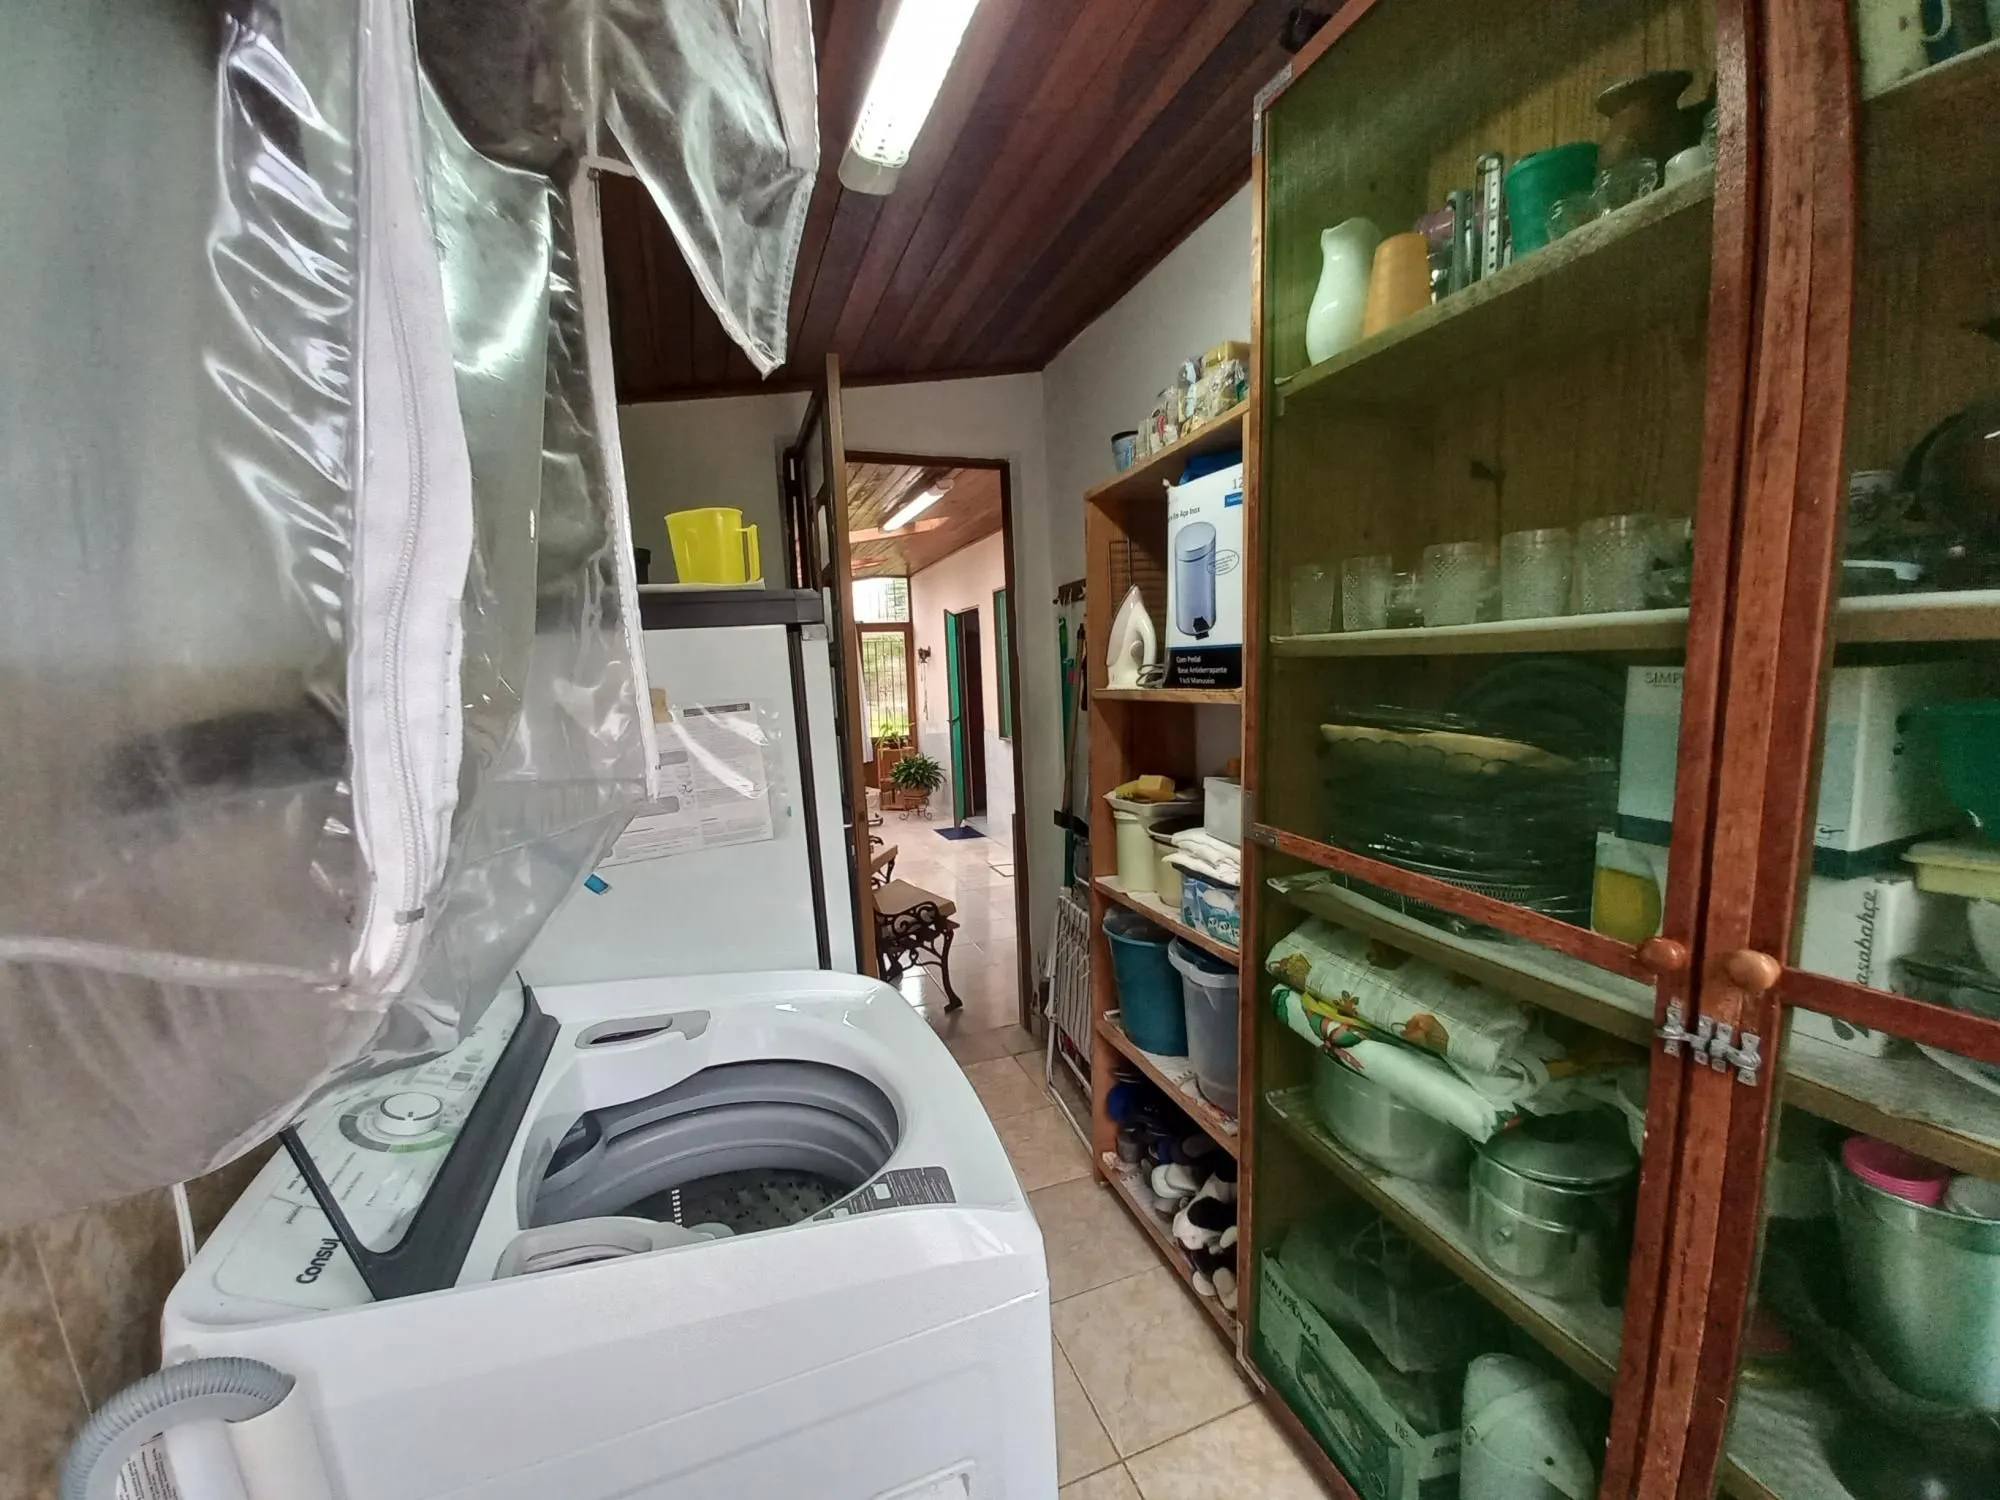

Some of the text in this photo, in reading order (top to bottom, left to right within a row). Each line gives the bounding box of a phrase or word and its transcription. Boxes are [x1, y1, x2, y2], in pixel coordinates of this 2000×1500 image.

[1190, 506, 1201, 515] Inox
[1189, 666, 1228, 675] Antiderrapante
[295, 1236, 341, 1285] Consul
